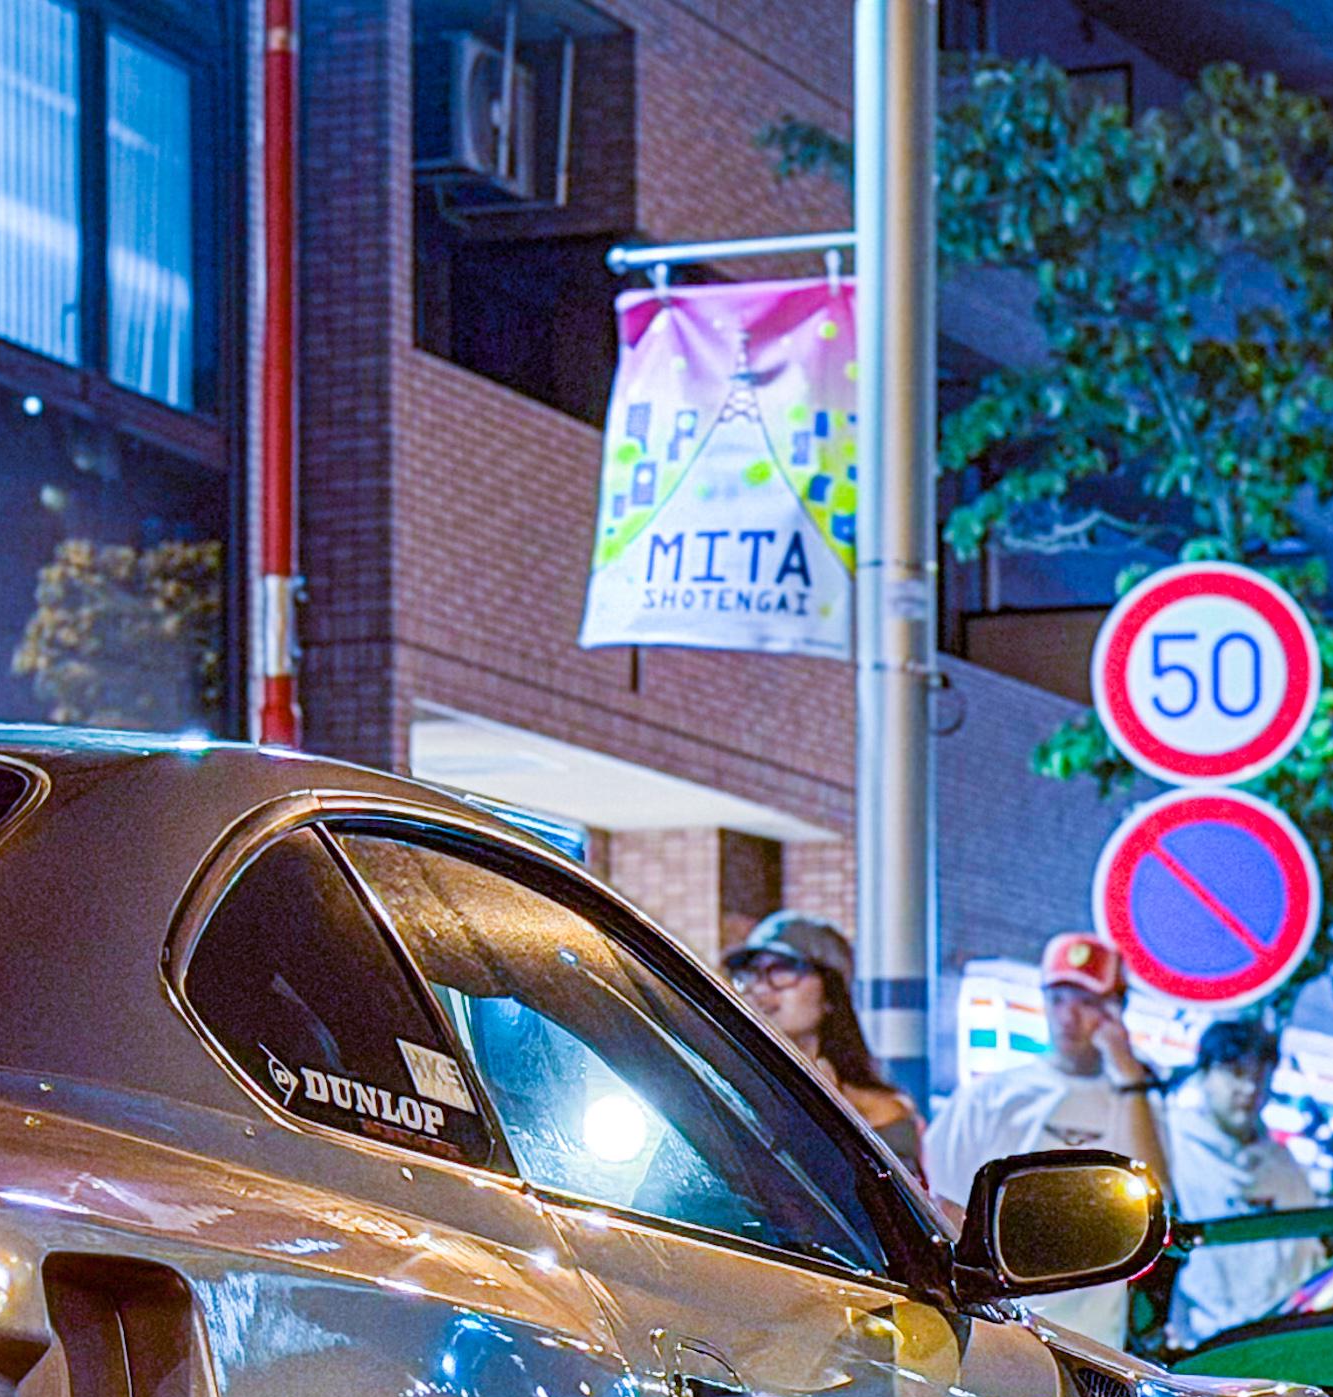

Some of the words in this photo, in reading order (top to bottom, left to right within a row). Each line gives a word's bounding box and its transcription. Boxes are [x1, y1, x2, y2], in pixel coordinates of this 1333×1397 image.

[644, 530, 814, 588] MITA
[642, 588, 813, 616] SHOTENGAI
[1151, 632, 1262, 718] 50
[300, 1067, 445, 1136] DUNLOP
